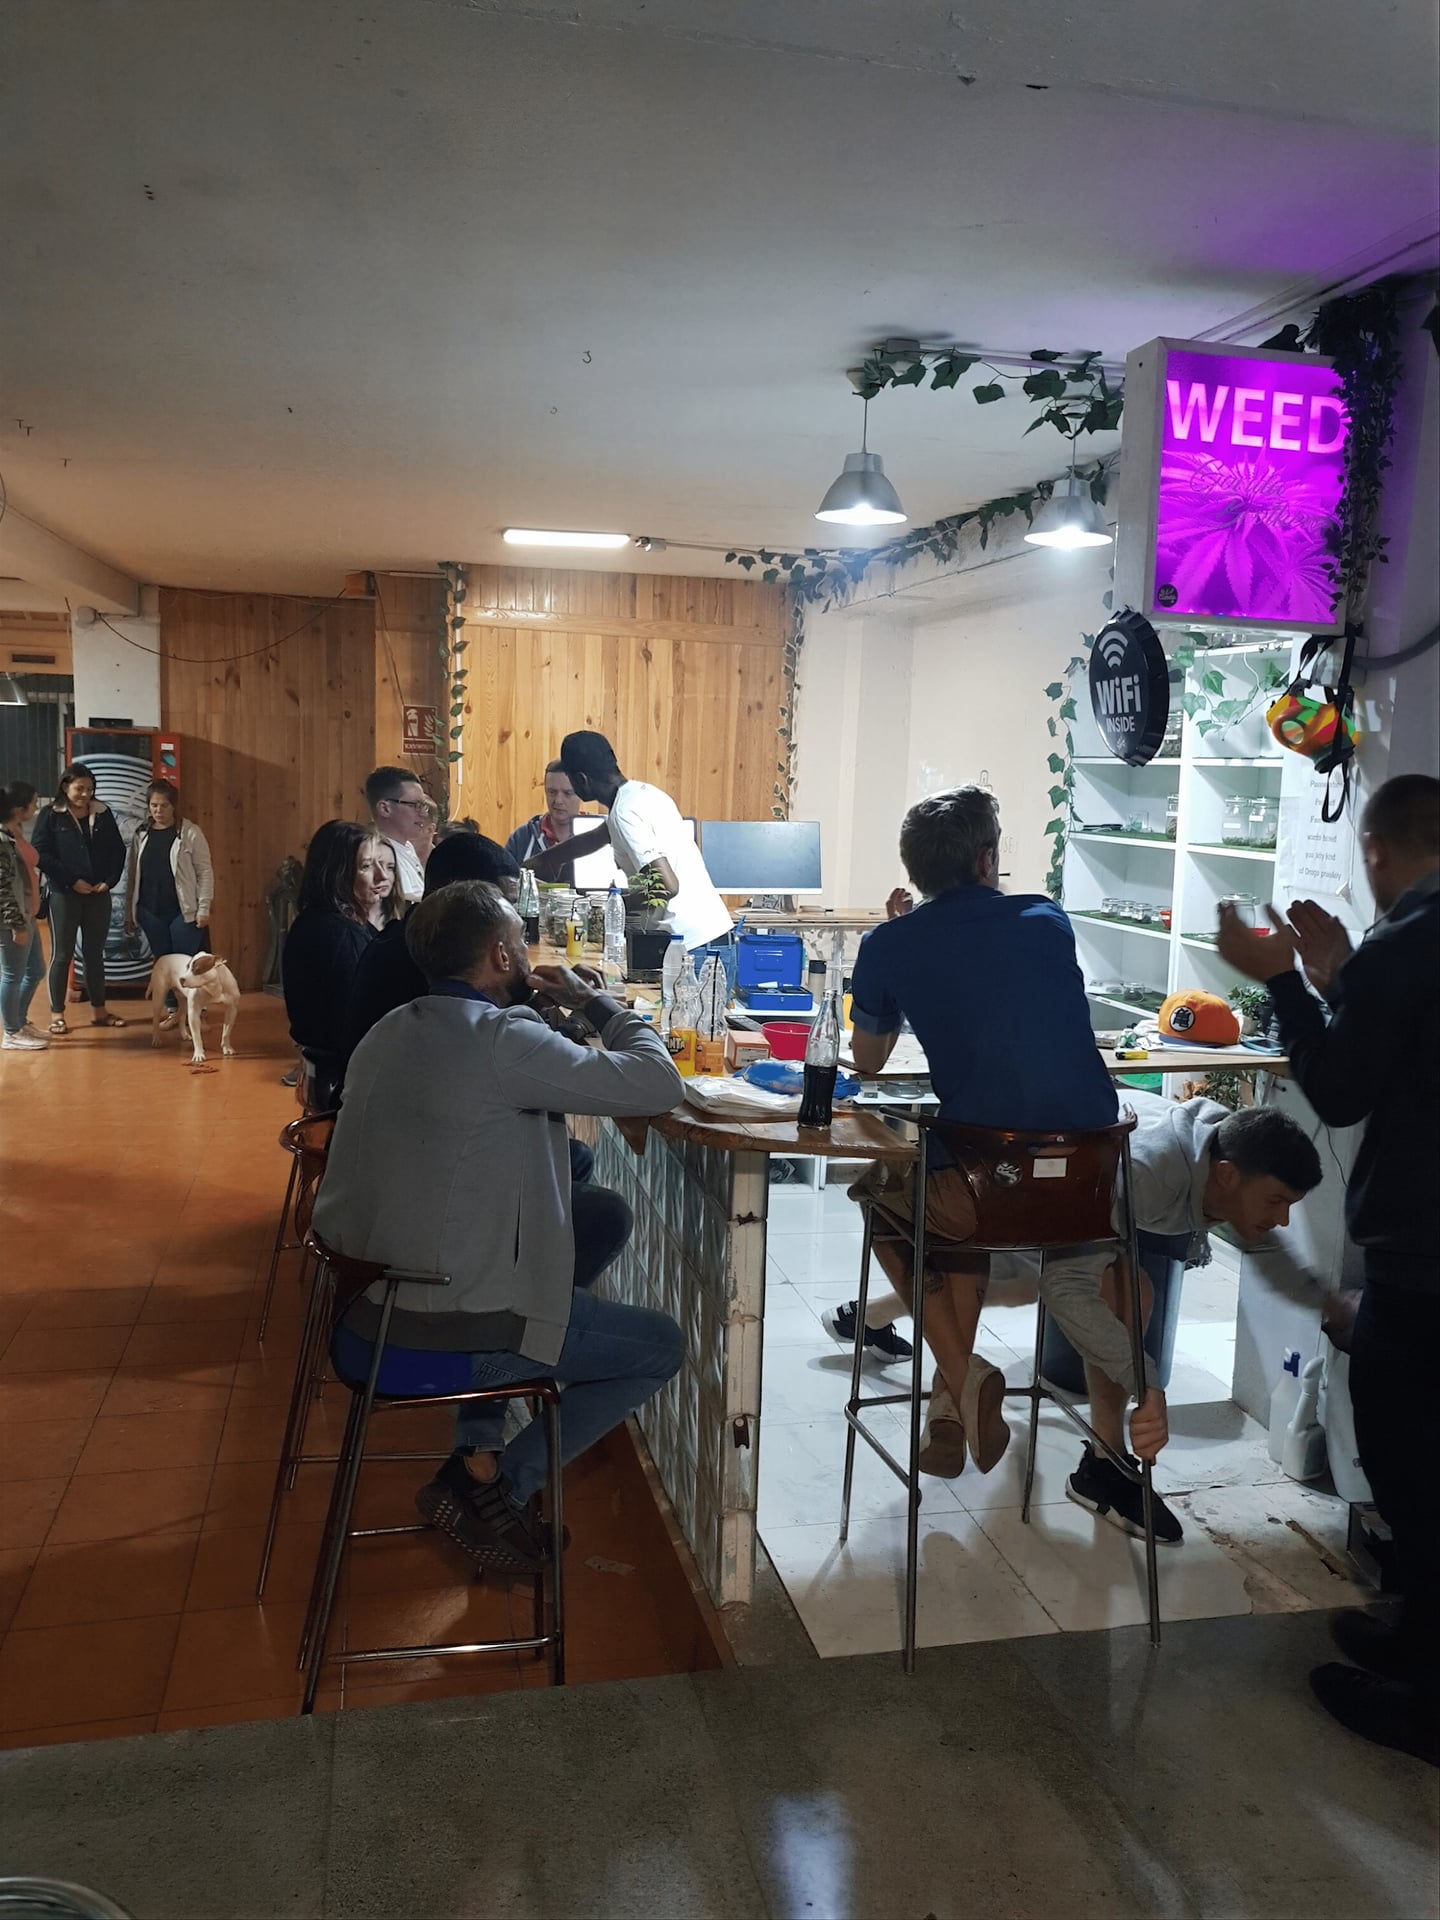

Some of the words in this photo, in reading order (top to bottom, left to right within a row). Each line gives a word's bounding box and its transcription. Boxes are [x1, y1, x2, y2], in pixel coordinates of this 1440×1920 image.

[1166, 379, 1349, 454] WEED
[1095, 674, 1141, 715] WiFi
[1106, 716, 1135, 733] INSIDE
